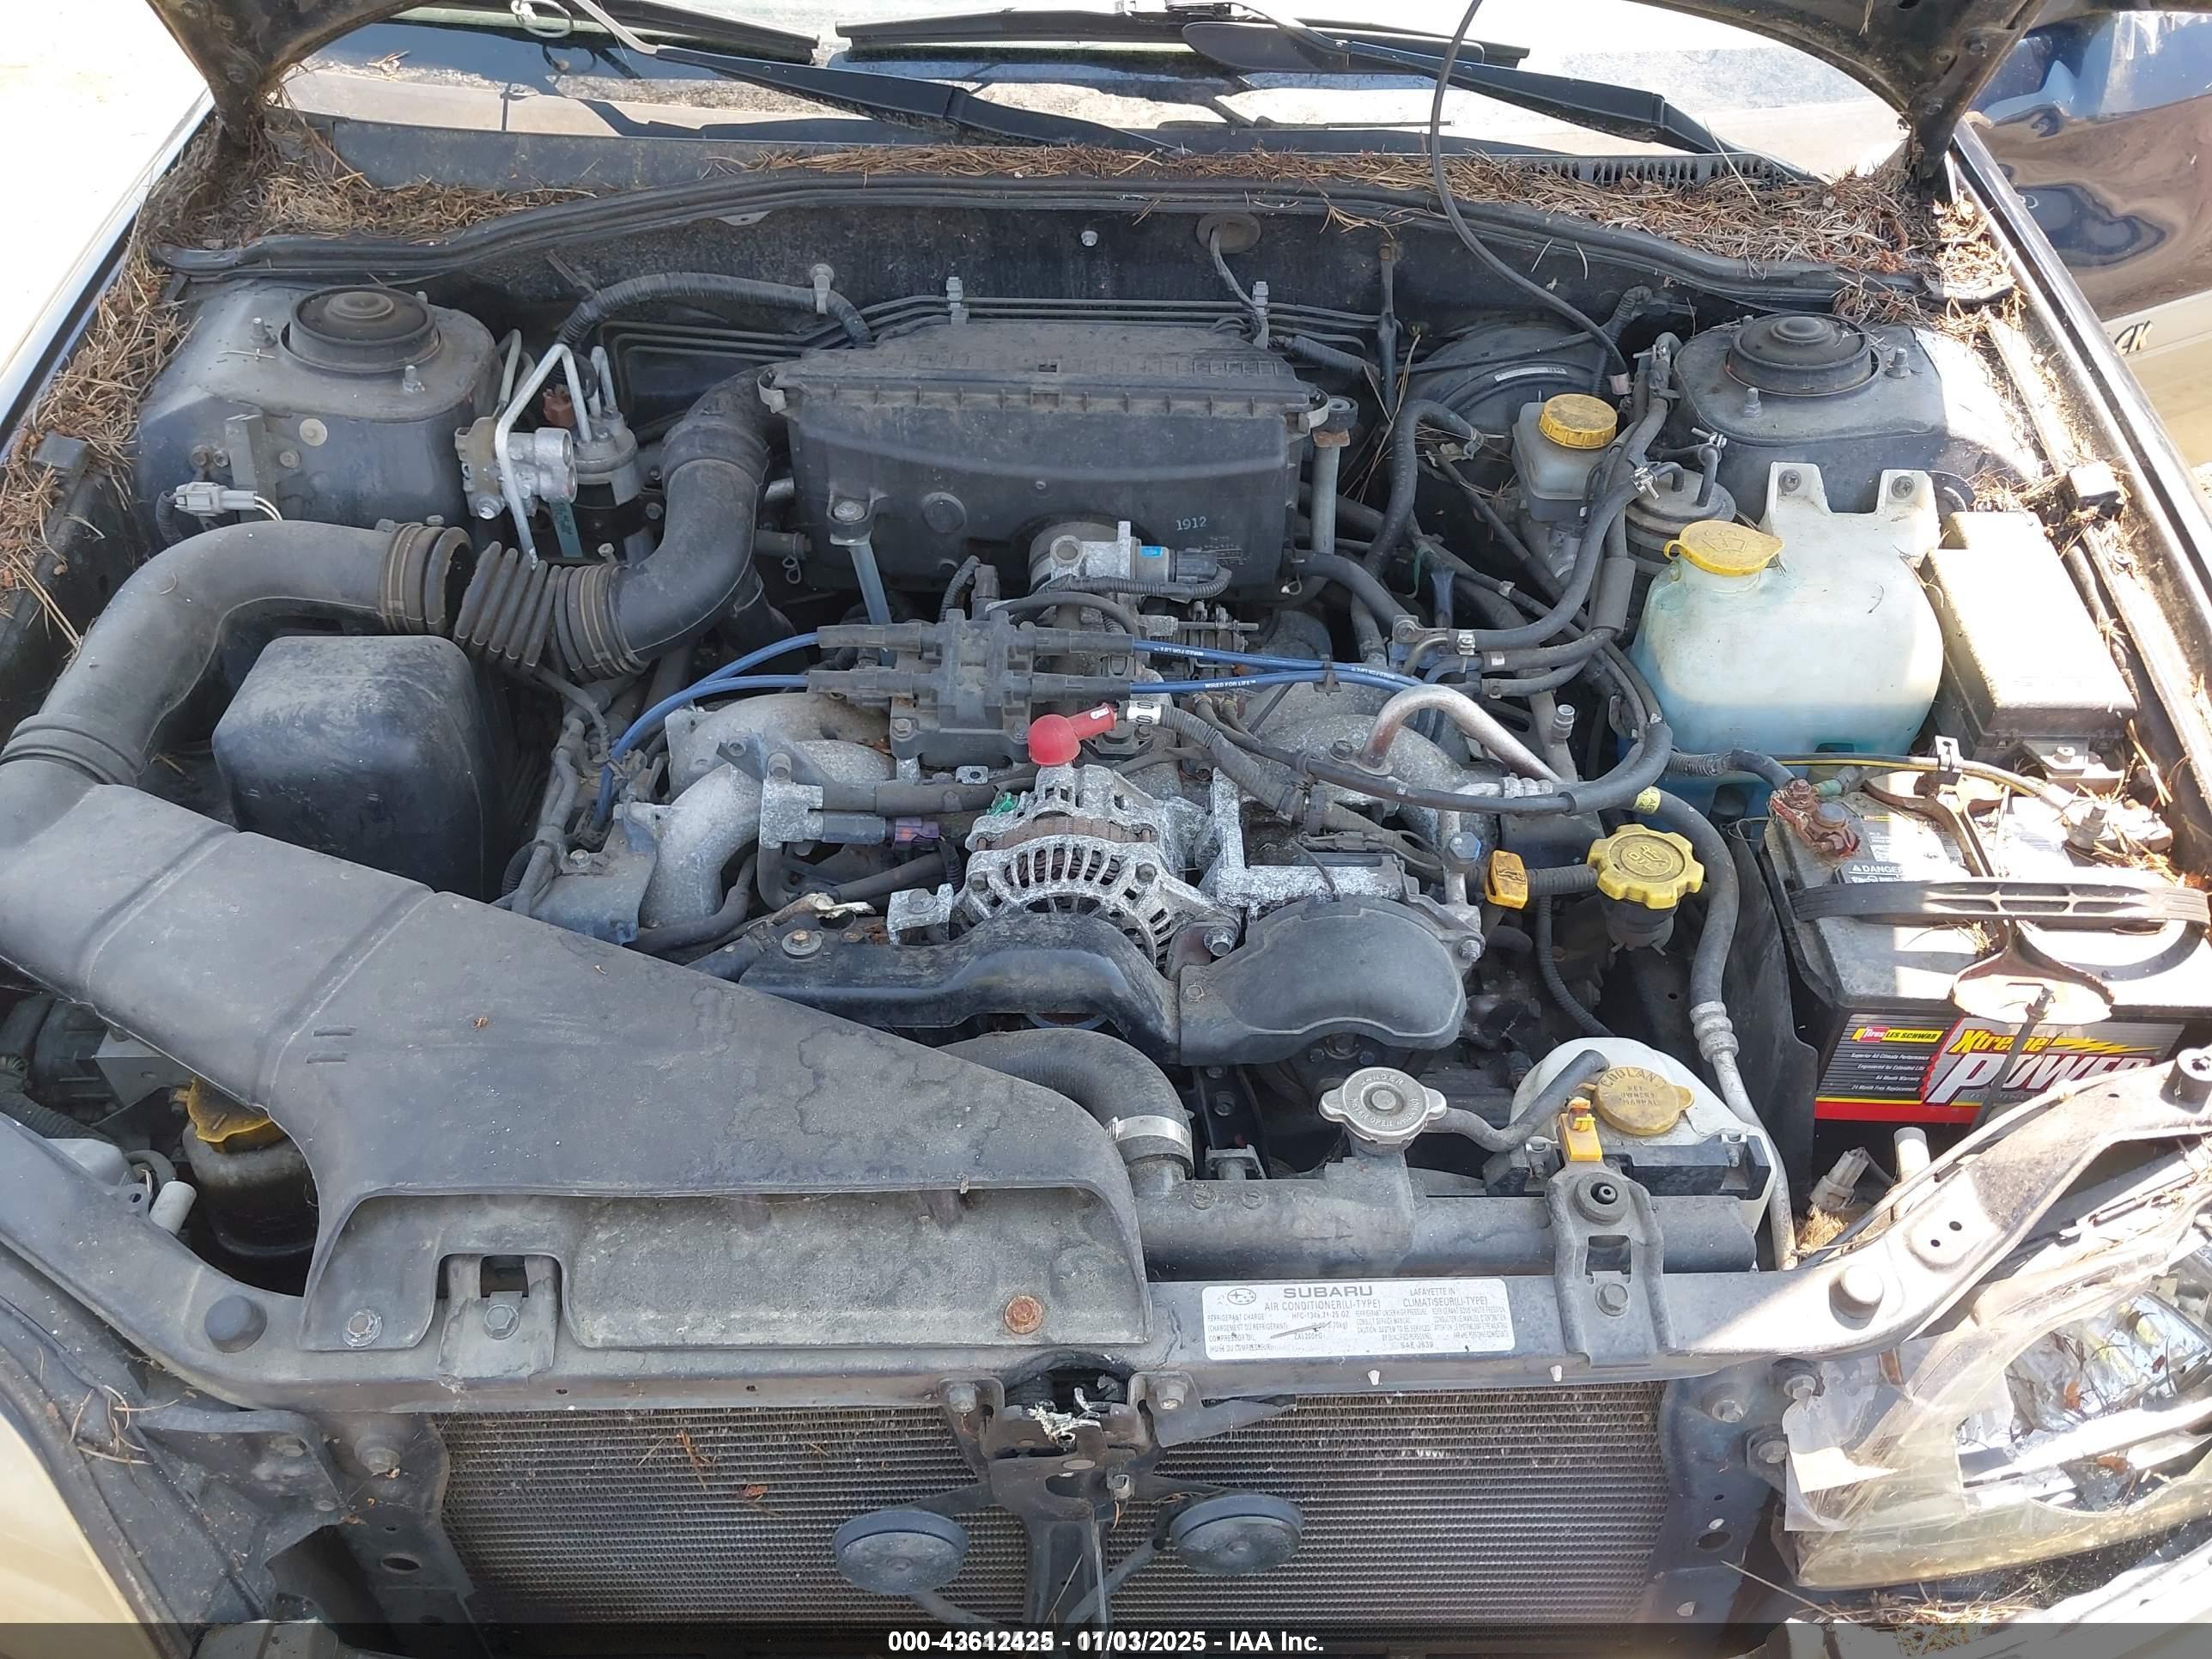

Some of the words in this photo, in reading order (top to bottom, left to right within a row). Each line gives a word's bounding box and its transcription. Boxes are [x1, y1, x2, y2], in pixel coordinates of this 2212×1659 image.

[1176, 516, 1207, 531] 1912
[1627, 851, 1654, 871] OIL
[1863, 1027, 1886, 1038] Tires
[1284, 1285, 1374, 1298] SUBARU
[1265, 1302, 1279, 1311] AIR
